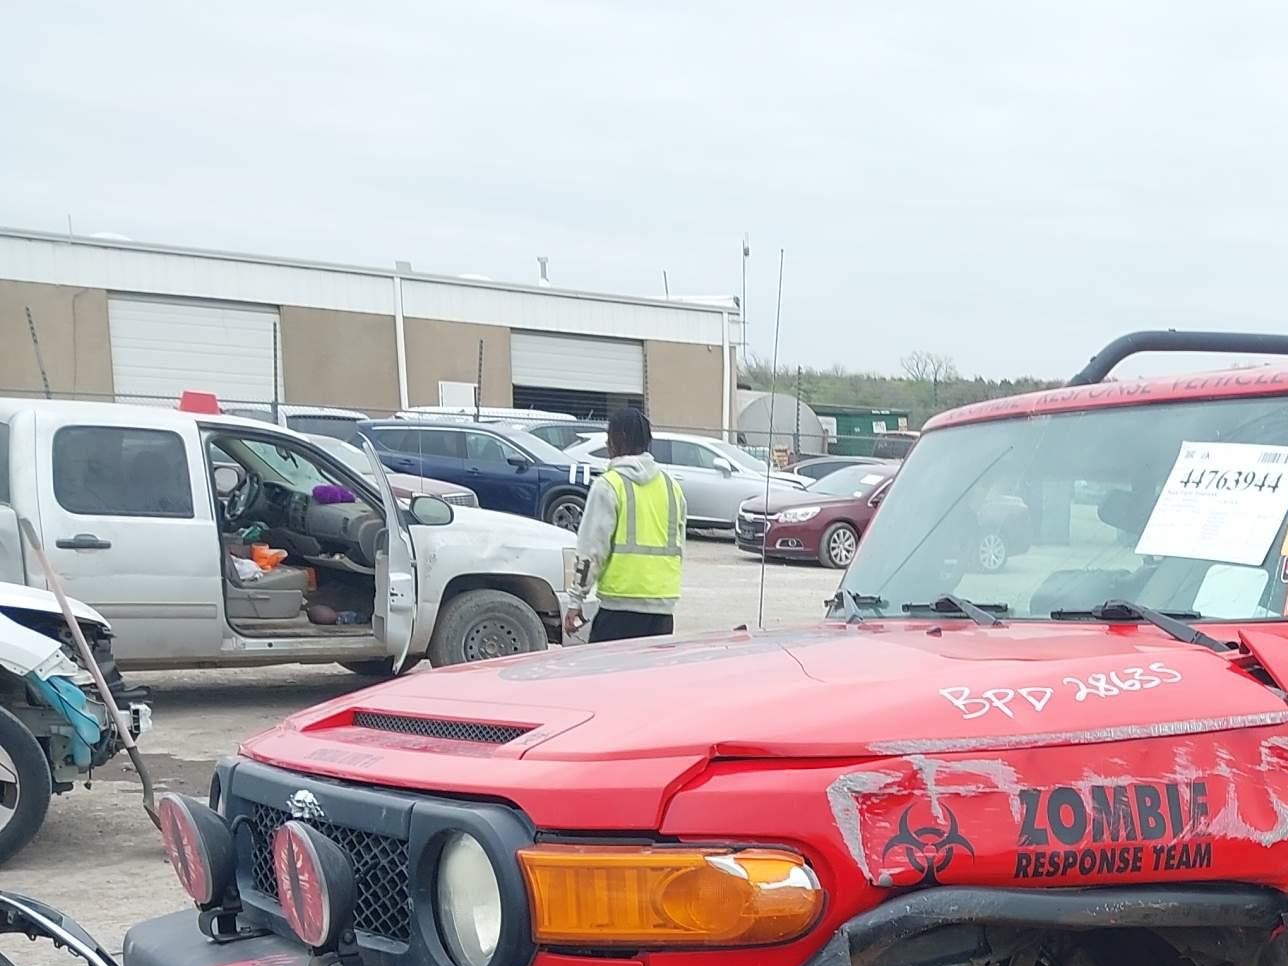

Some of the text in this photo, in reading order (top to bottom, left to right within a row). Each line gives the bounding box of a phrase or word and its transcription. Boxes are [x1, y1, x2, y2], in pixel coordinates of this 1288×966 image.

[1179, 468, 1283, 493] 44763944
[939, 662, 1182, 719] BPD 28635
[1019, 782, 1209, 846] ZOMBIE
[1014, 842, 1211, 879] RESPONSE TEAM
